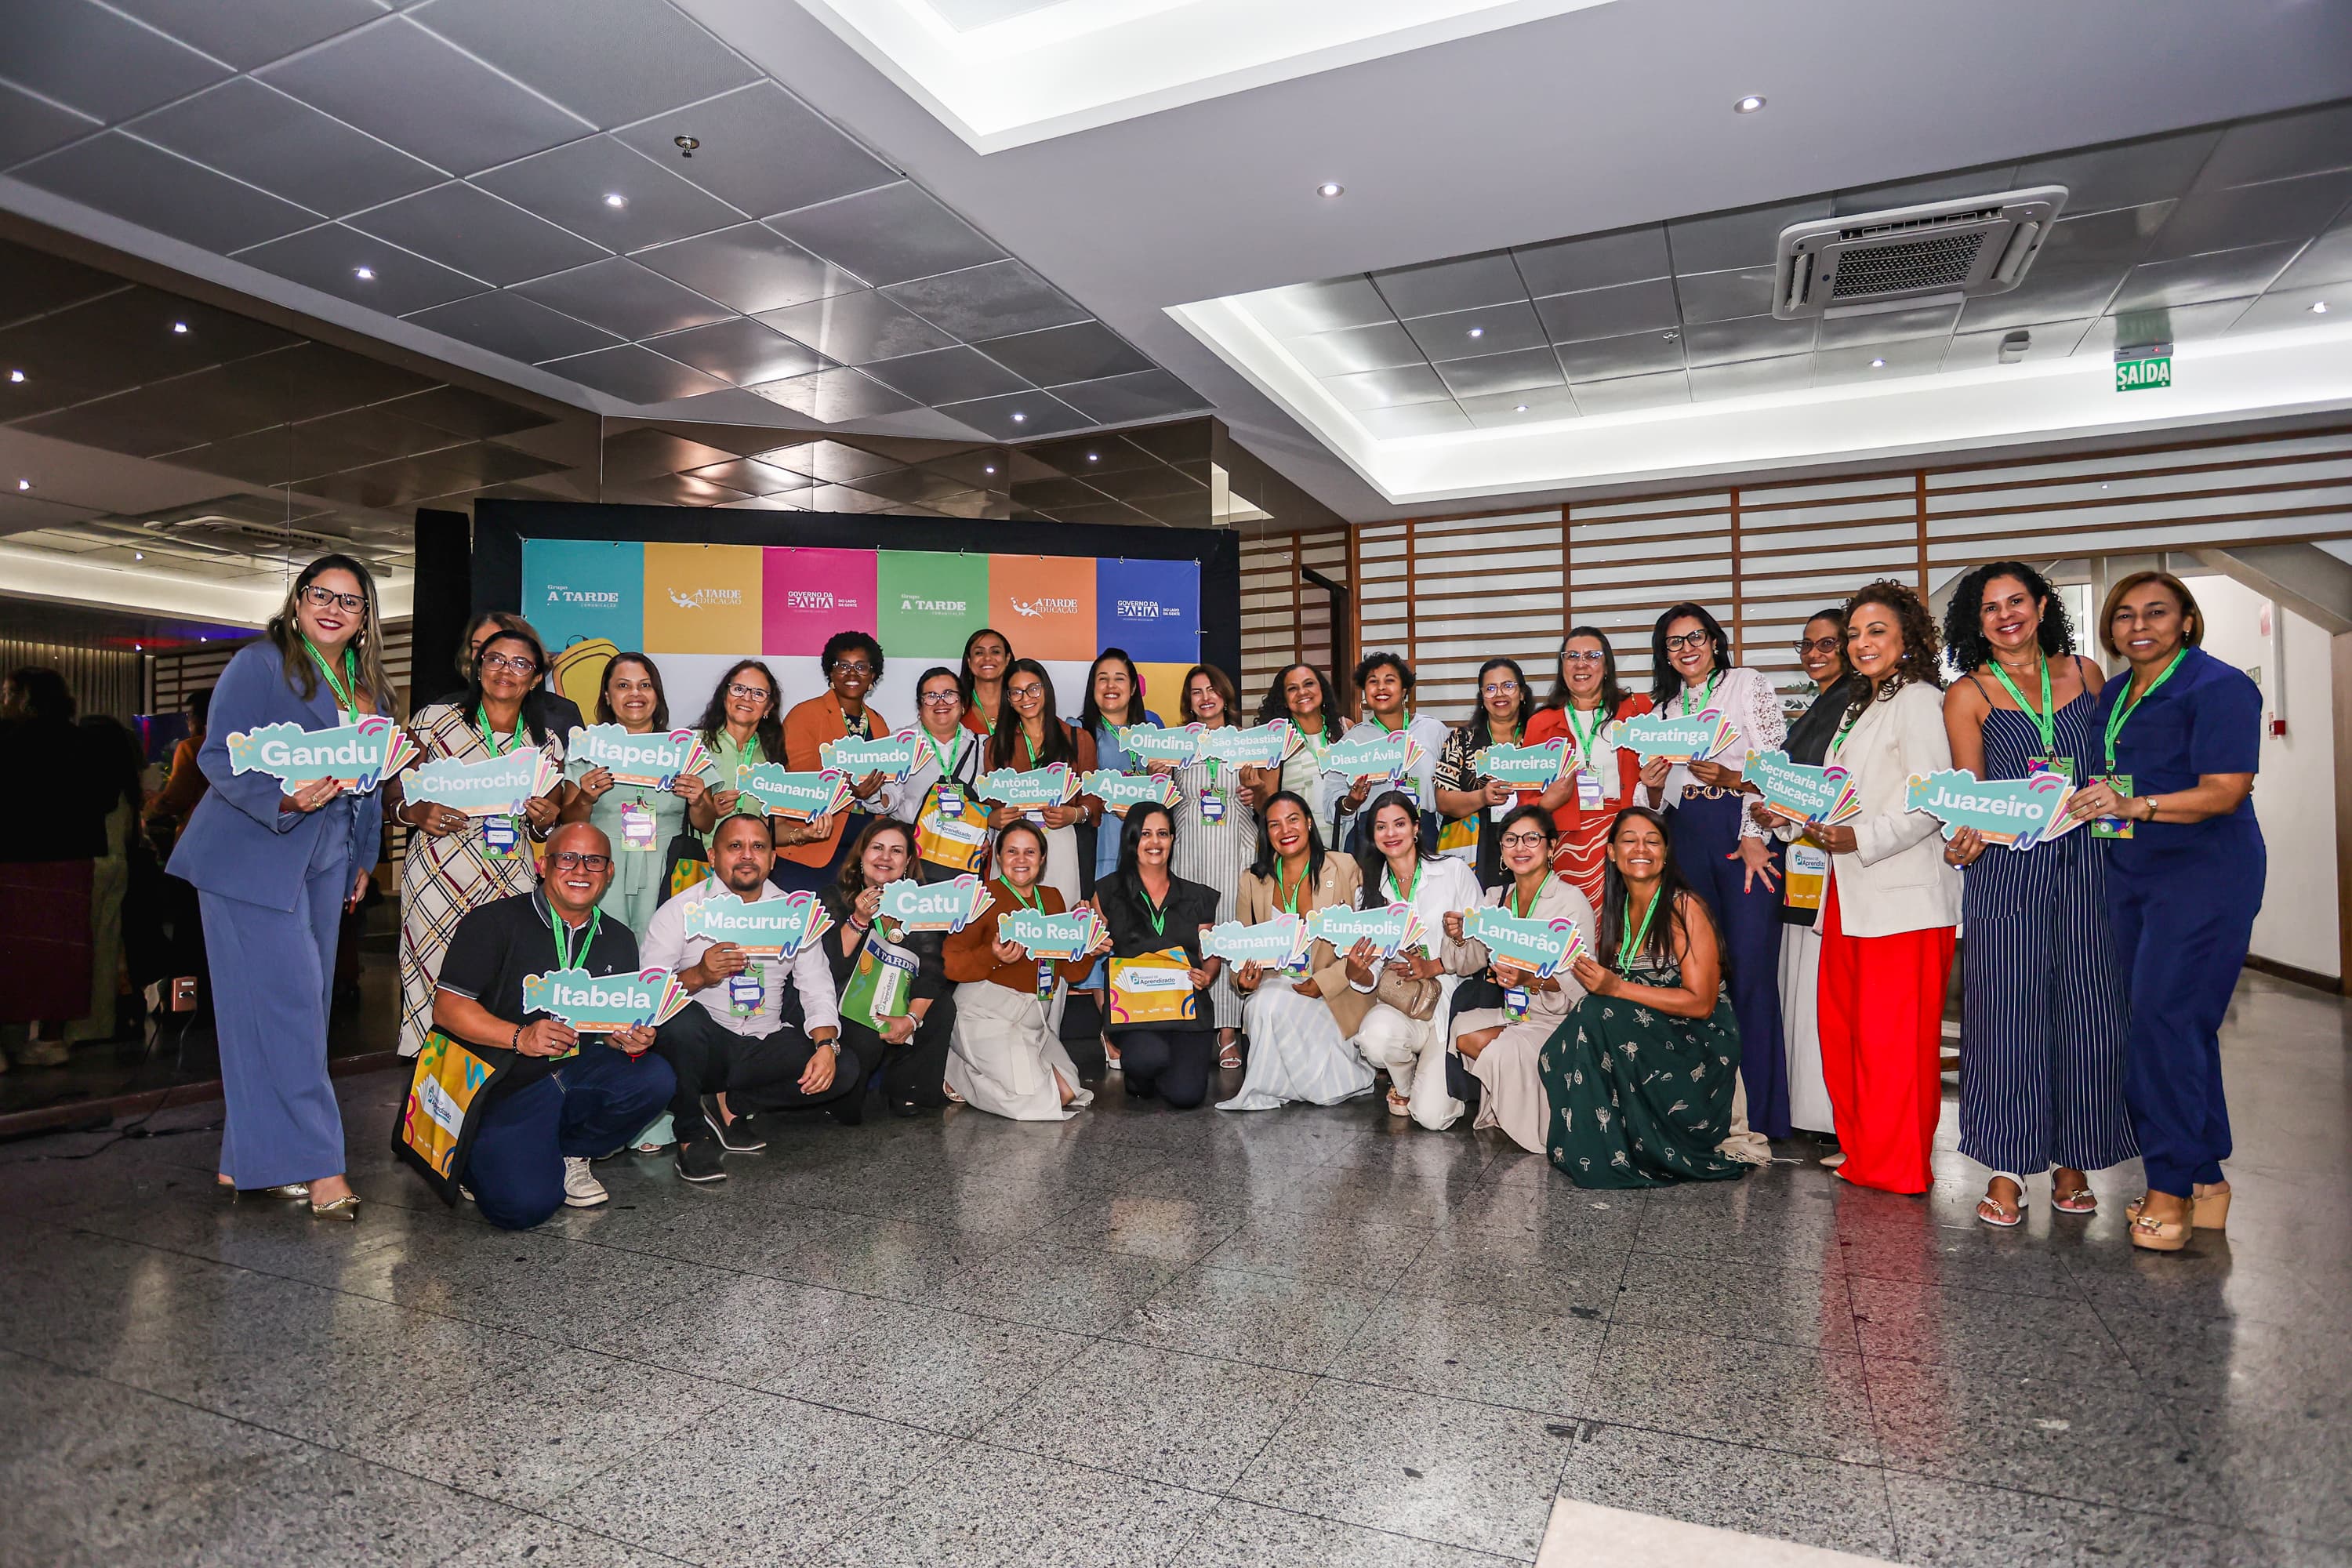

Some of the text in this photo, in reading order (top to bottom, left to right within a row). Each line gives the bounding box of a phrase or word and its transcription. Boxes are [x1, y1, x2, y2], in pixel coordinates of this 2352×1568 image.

[2118, 361, 2169, 386] SAÍDA
[547, 591, 619, 602] A TARDE
[704, 590, 741, 598] TARDE
[788, 597, 833, 608] BAHIA
[902, 600, 966, 611] A TARDE
[1044, 598, 1077, 608] TARDE
[1117, 606, 1159, 617] BAHIA
[1131, 734, 1194, 751] Olindina
[1213, 735, 1283, 746] São Sebastião
[1629, 728, 1709, 745] Paratinga
[260, 739, 378, 767] Gandu
[590, 736, 681, 768] Itapebi
[837, 750, 909, 764] Brumado
[1224, 746, 1269, 757] do Passé
[1330, 754, 1359, 766] Dias
[1491, 756, 1557, 770] Barreiras
[423, 771, 531, 793] Chorrochó
[992, 777, 1040, 789] Antônio
[1759, 760, 1836, 797] Secretaria da
[753, 778, 829, 800] Guanambi
[1009, 786, 1061, 798] Cardoso
[1098, 778, 1157, 800] Aporá
[1766, 777, 1824, 808] Educação
[1928, 786, 2044, 819] Juazeiro
[897, 892, 959, 914] Catu
[705, 913, 801, 930] Macururé
[1323, 919, 1401, 936] Eunápolis
[1014, 922, 1083, 941] Rio Real
[1478, 923, 1560, 953] Lamarão
[1214, 935, 1290, 951] Camamu
[874, 947, 915, 973] A TARDE
[1140, 977, 1175, 985] Aprendizado
[552, 983, 652, 1009] Itabela
